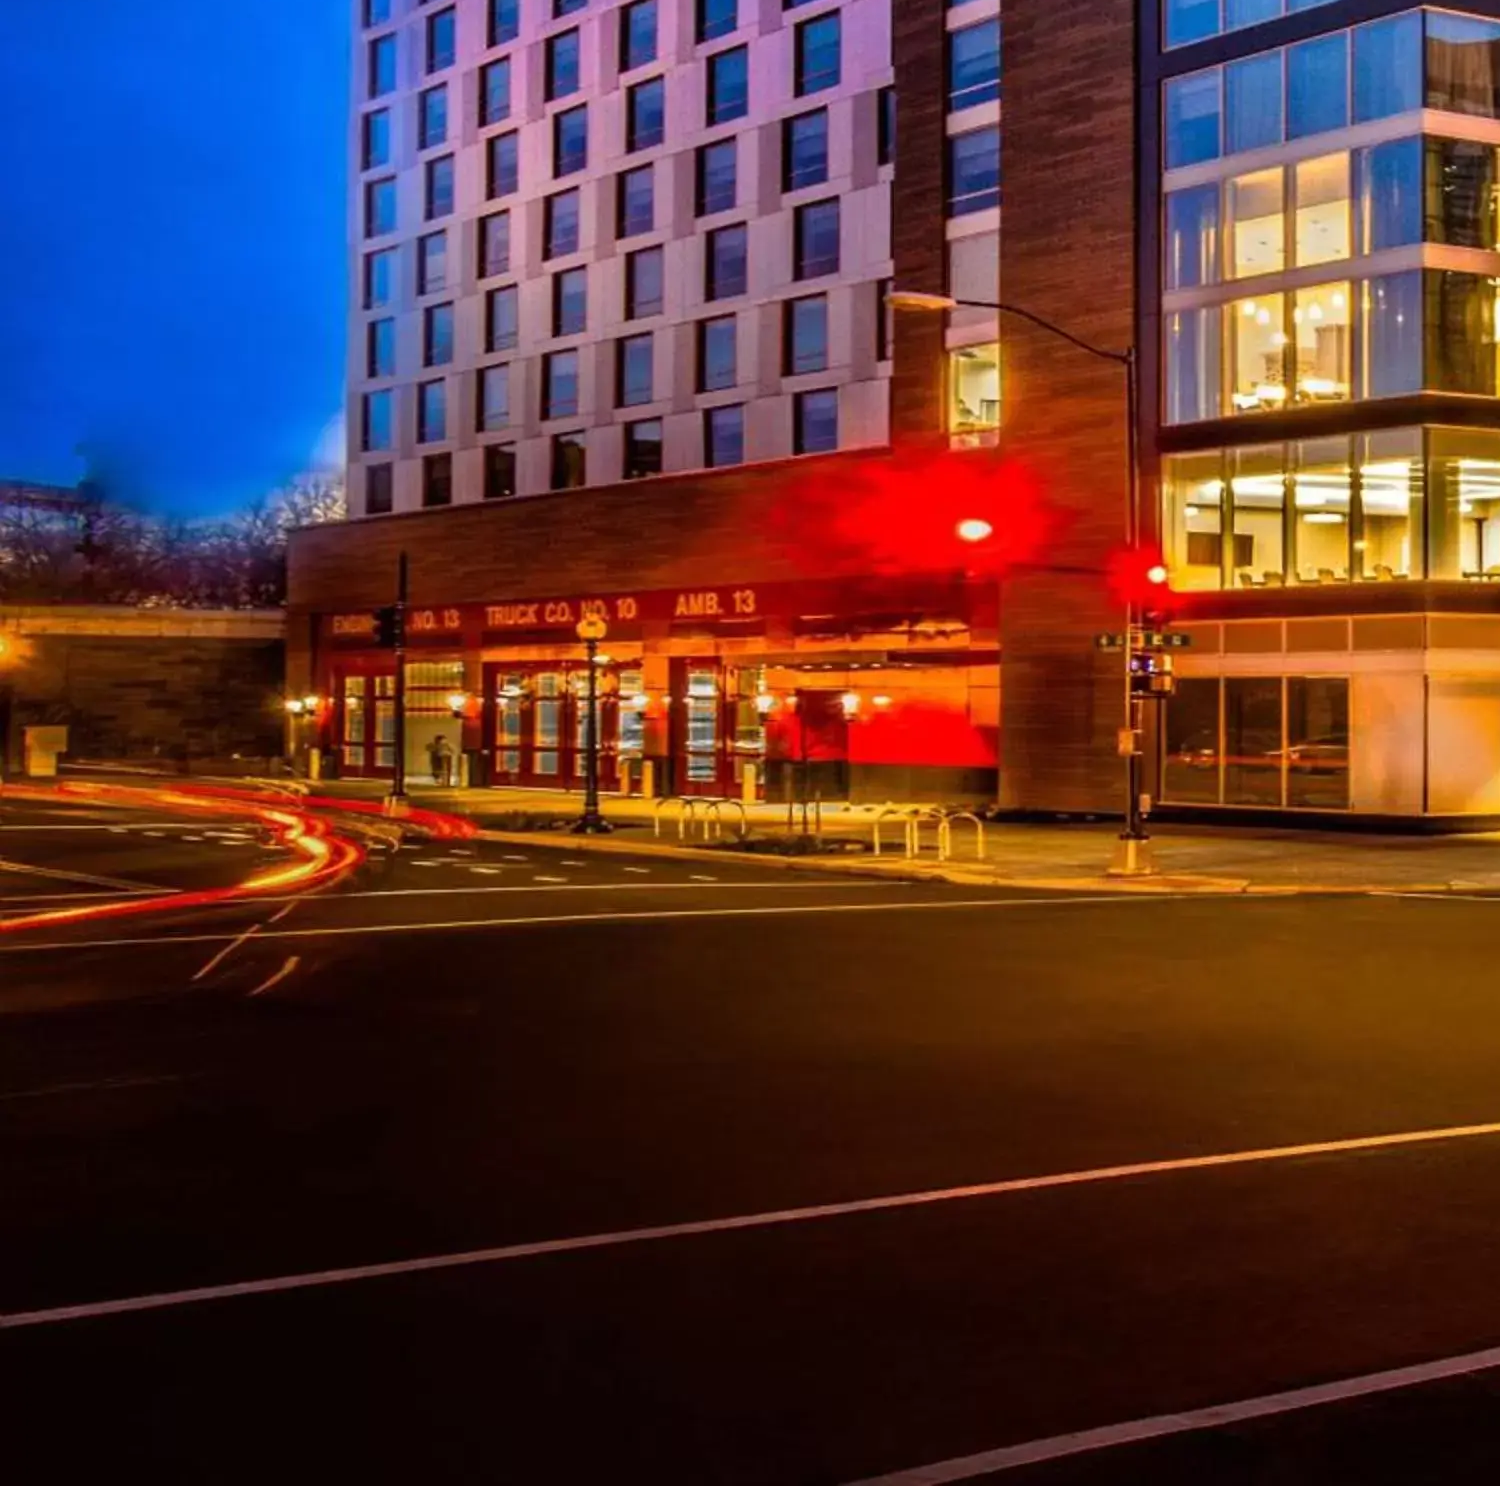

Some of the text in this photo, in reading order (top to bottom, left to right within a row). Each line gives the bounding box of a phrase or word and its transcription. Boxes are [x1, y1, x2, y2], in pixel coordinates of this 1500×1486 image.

[485, 603, 539, 626] TRUCK
[544, 601, 574, 623] CO.
[616, 597, 637, 619] 10
[675, 589, 755, 617] AMB. 13
[444, 608, 460, 628] 13
